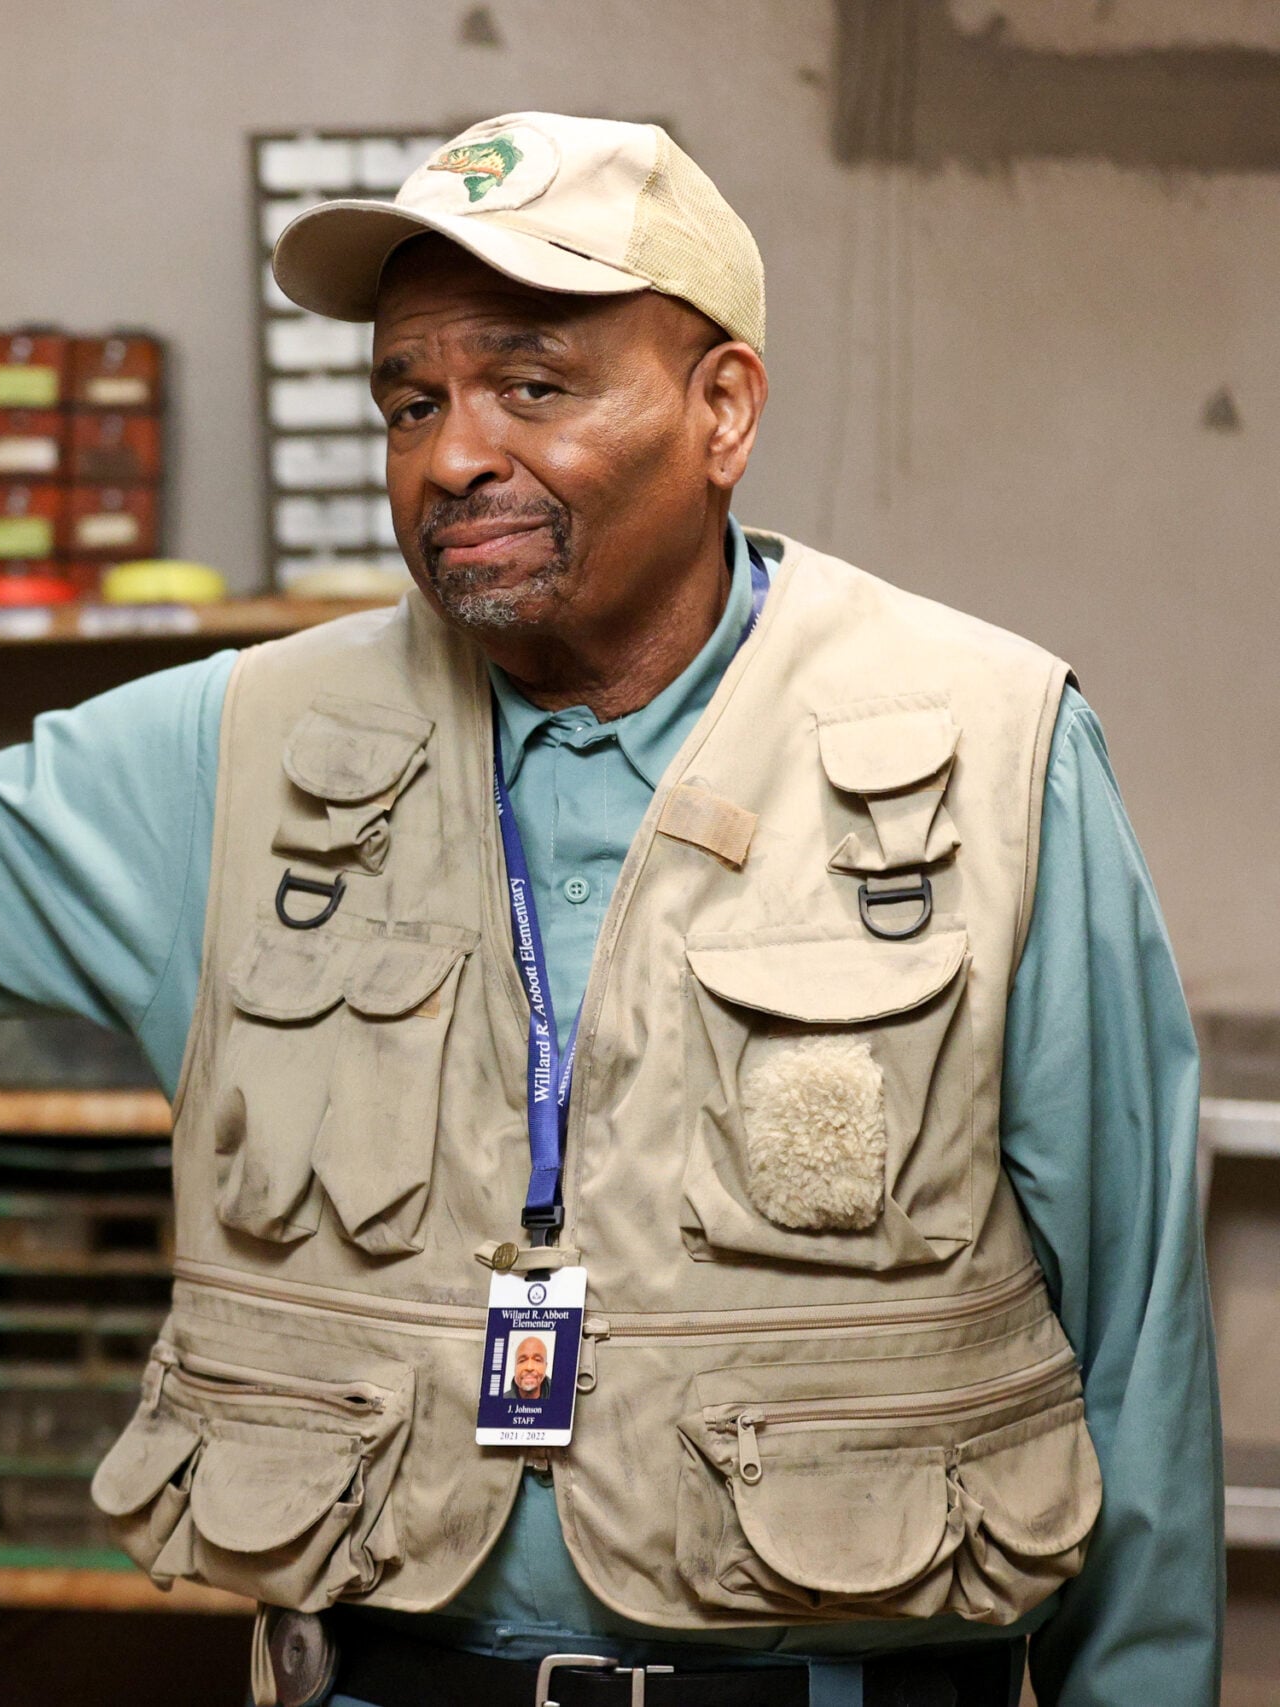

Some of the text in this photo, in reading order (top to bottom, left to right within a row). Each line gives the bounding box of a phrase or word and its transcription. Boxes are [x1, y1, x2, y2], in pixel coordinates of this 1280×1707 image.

[510, 878, 551, 1103] Willard R. Abbott Elementary
[502, 1310, 569, 1319] Willard R. Abbott
[512, 1319, 556, 1330] Elementary
[507, 1404, 542, 1414] J. Johnson
[513, 1416, 535, 1425] STAFF
[500, 1432, 518, 1440] 2021
[527, 1432, 545, 1440] 2022
